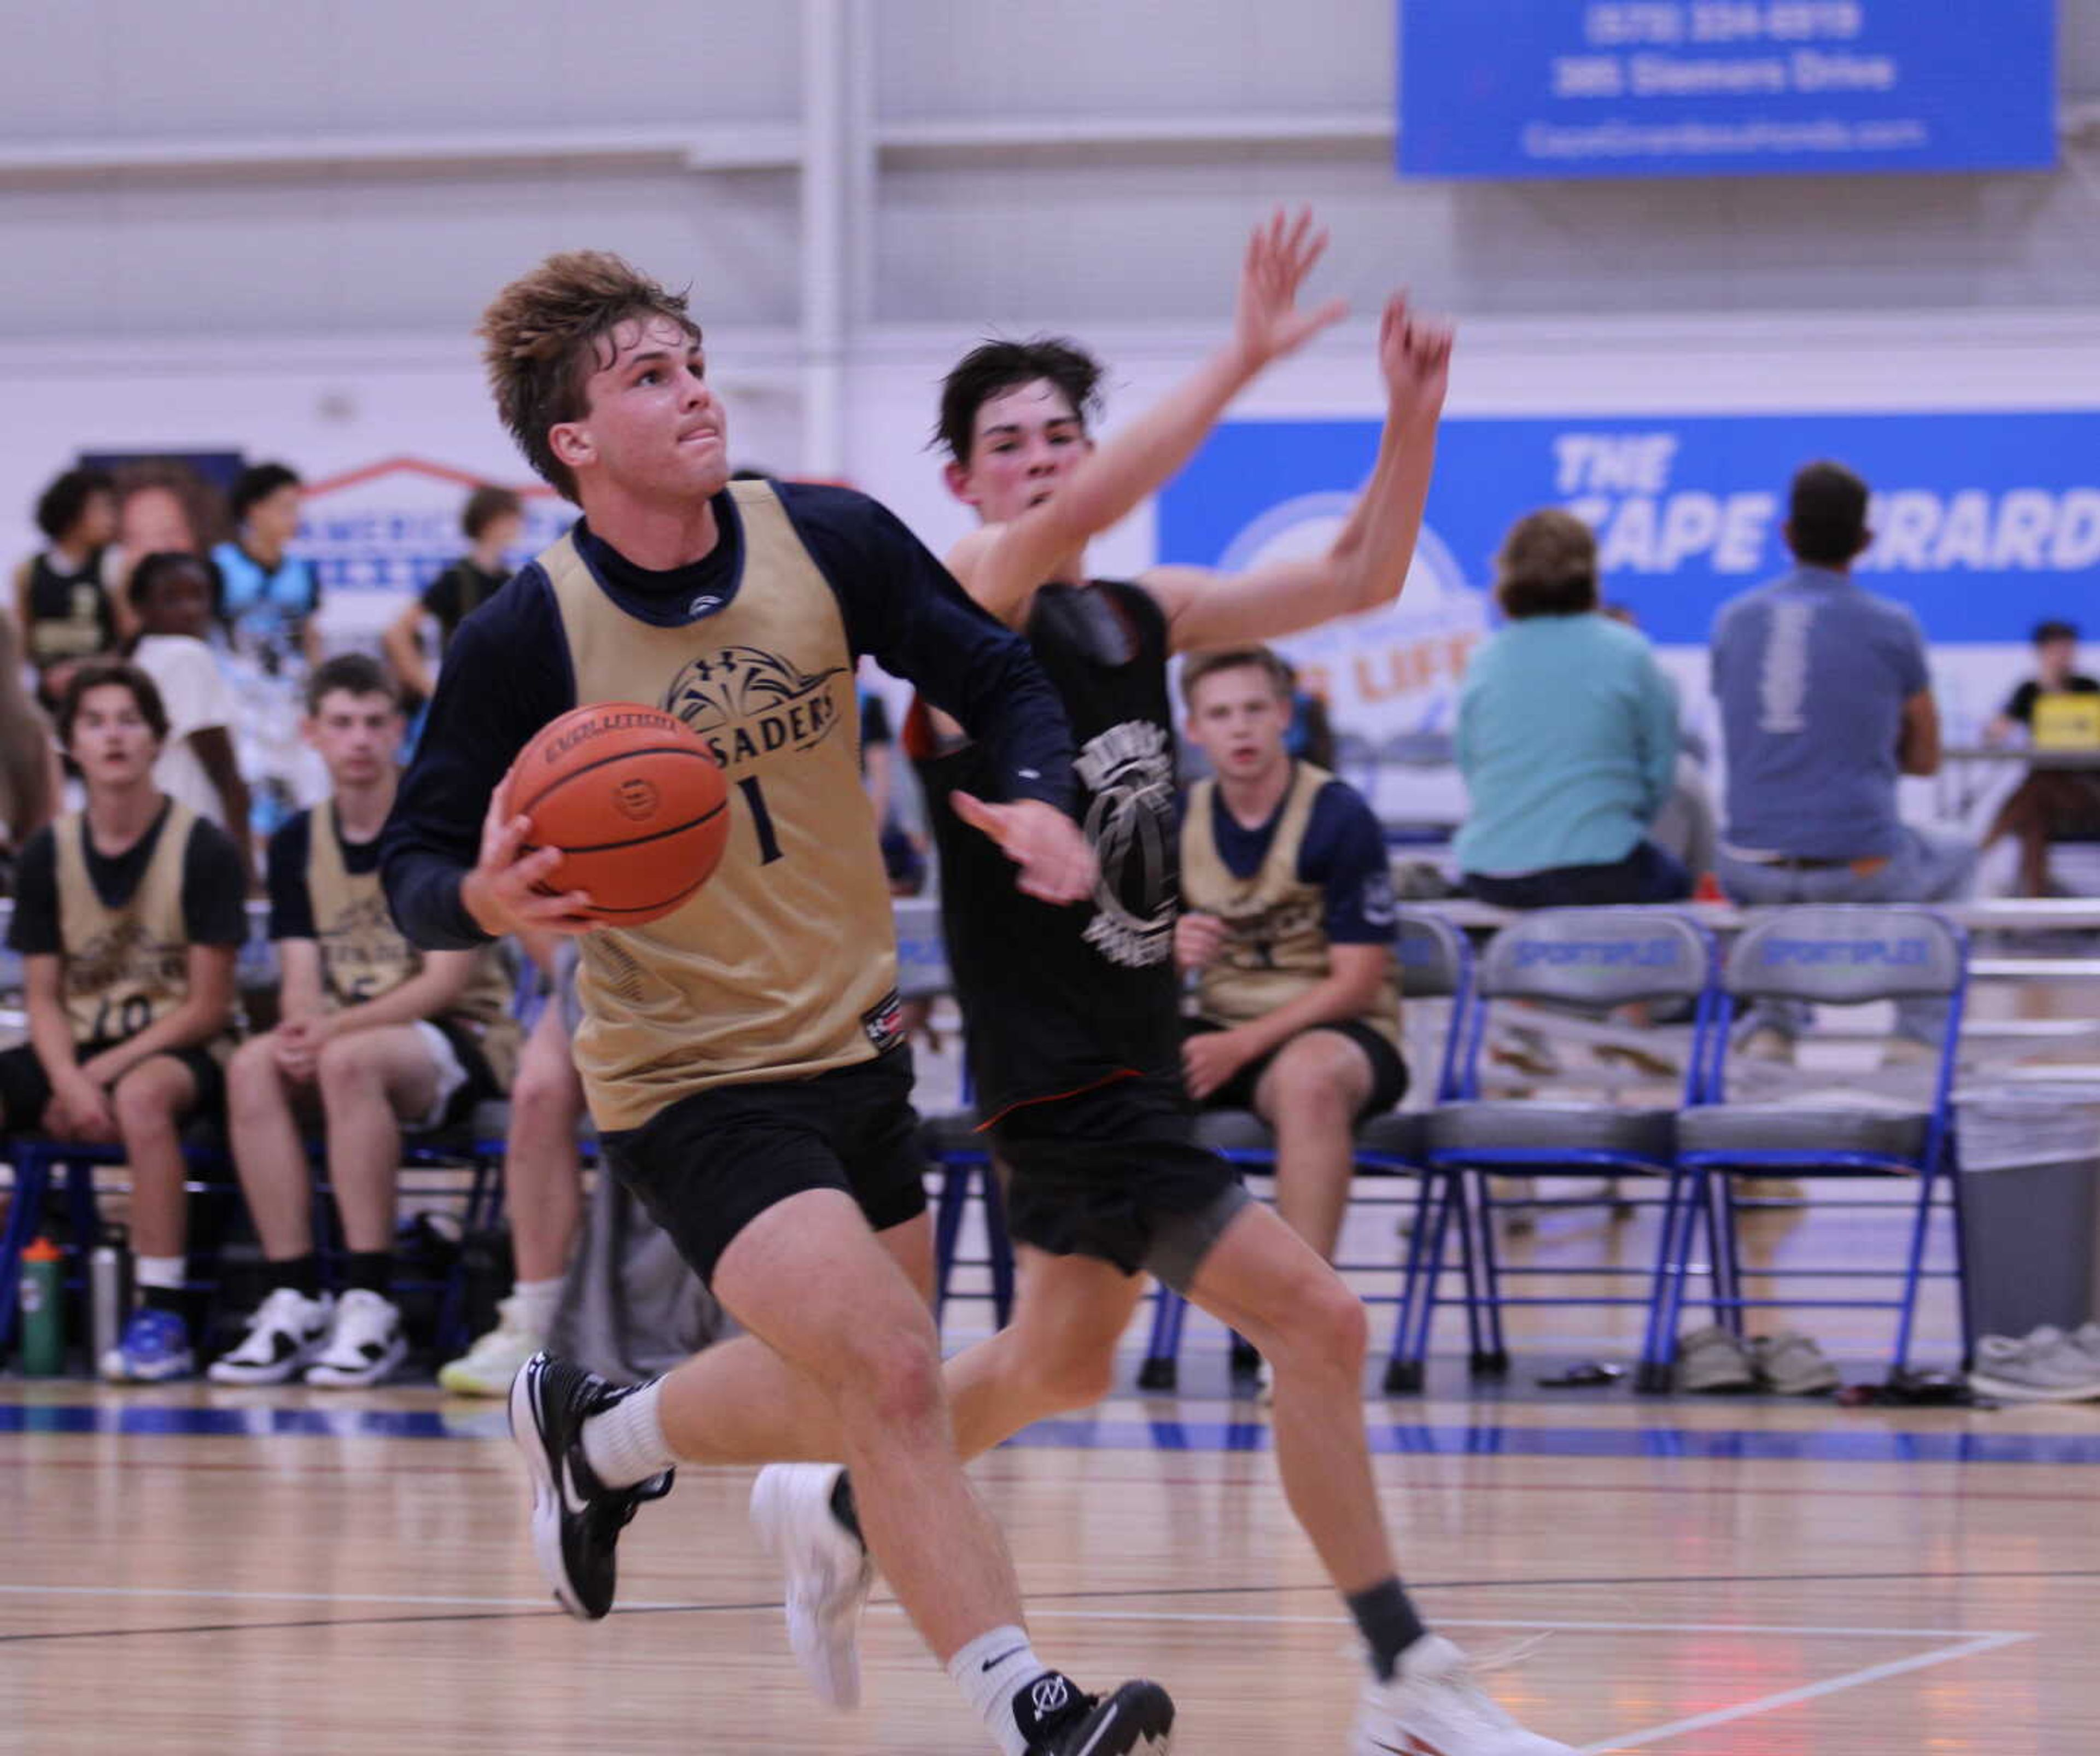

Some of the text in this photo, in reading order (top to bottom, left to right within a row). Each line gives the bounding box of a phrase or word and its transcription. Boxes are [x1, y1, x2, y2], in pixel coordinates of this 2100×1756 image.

[1553, 434, 1679, 494] THE
[709, 693, 835, 769] SADERS
[735, 774, 784, 866] 1
